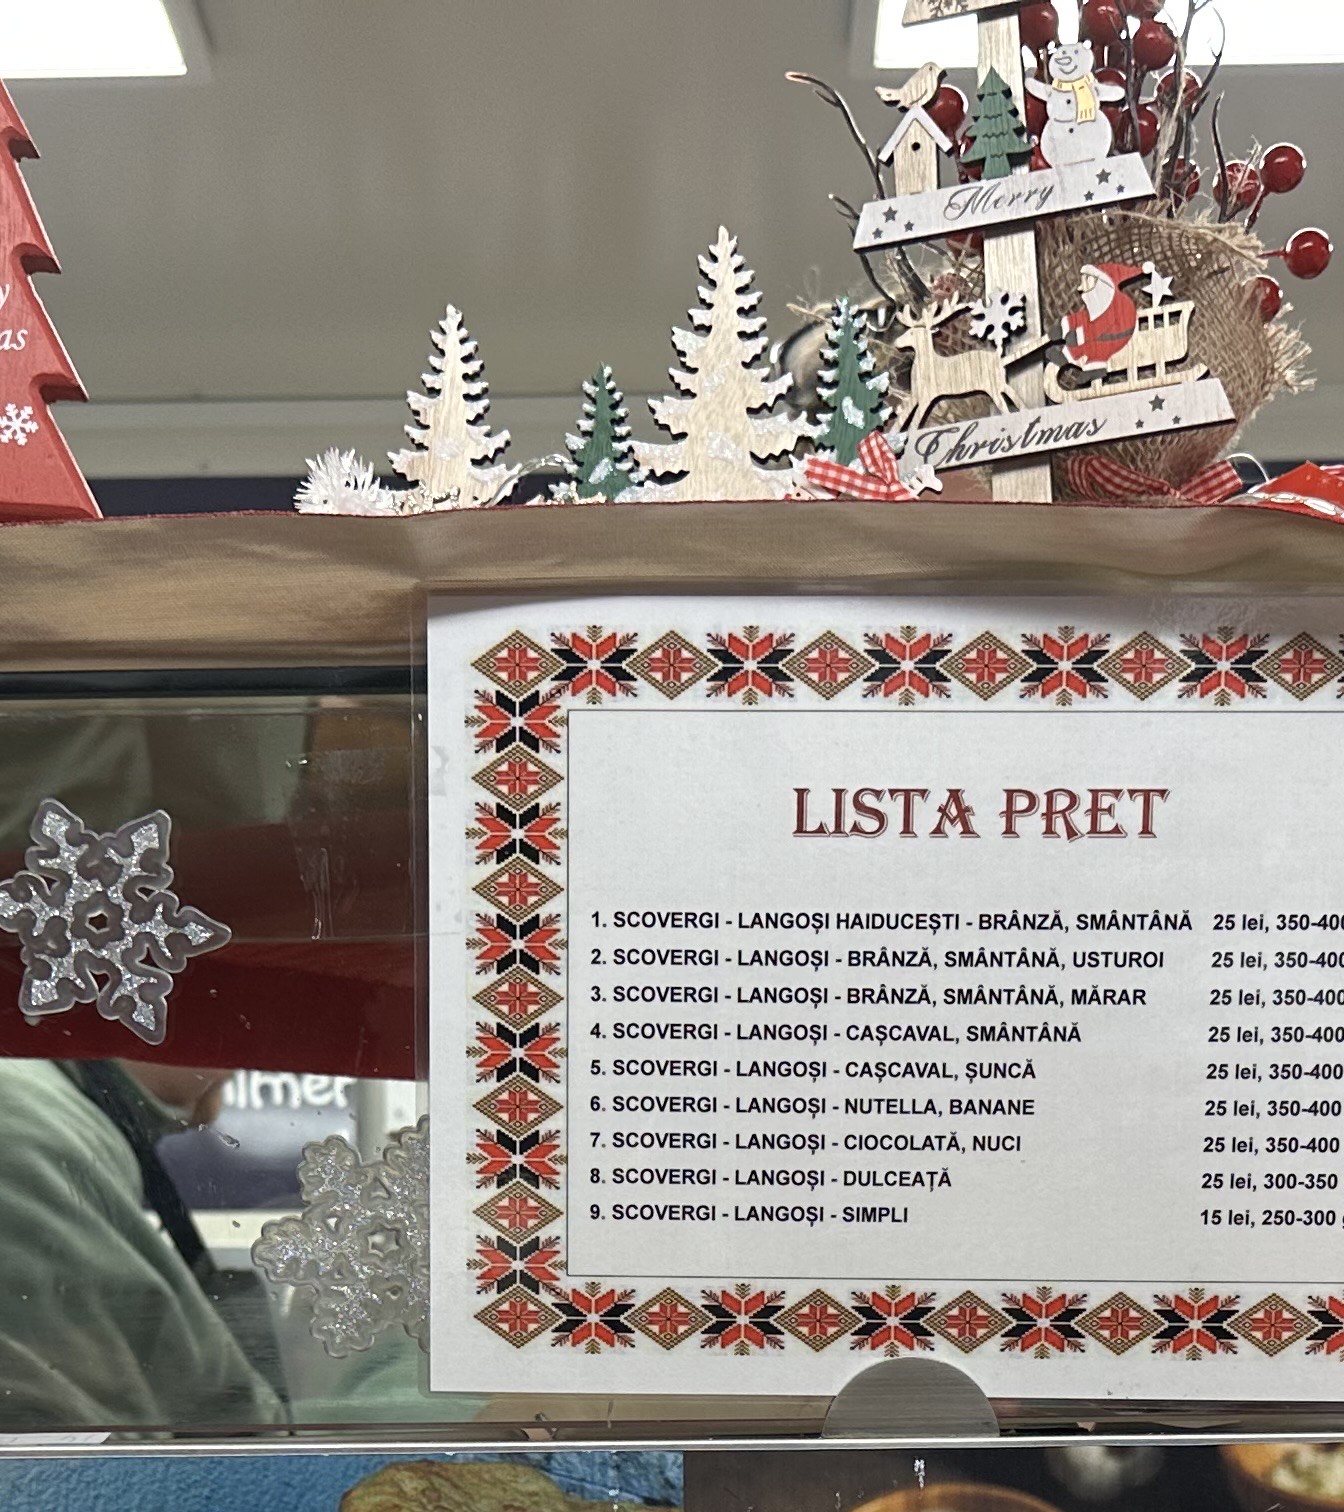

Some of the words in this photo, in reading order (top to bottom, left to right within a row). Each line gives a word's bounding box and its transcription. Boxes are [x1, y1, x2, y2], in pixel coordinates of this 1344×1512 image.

[943, 182, 1054, 221] Merry
[915, 415, 1108, 469] Christmas
[792, 787, 980, 839] LISTA
[999, 788, 1171, 842] PRET
[592, 911, 607, 928] 1.
[613, 911, 719, 929] SCOVERGI
[738, 912, 829, 935] LANGOȘI
[836, 913, 959, 936] HAIDUCEȘTI
[979, 910, 1069, 933] BRÂNZĂ,
[1076, 909, 1192, 930] SMÂNTÂNĂ
[1213, 914, 1235, 930] 25
[1242, 914, 1269, 933] lei,
[591, 948, 606, 965] 2.
[613, 948, 719, 966] SCOVERGI
[738, 950, 828, 972] LANGOȘI
[848, 946, 937, 970] BRÂNZĂ,
[944, 947, 1065, 971] SMÂNTÂNĂ,
[1073, 951, 1164, 968] USTUROI
[1211, 952, 1234, 968] 25
[1240, 952, 1267, 971] lei,
[590, 985, 606, 1002] 3.
[613, 986, 718, 1003] SCOVERGI
[737, 987, 828, 1009] LANGOȘI
[847, 984, 936, 1008] BRÂNZĂ,
[943, 984, 1064, 1008] SMÂNTÂNĂ,
[1071, 985, 1146, 1005] MĂRAR
[1209, 989, 1232, 1006] 25
[1238, 989, 1265, 1008] lei,
[590, 1023, 606, 1039] 4.
[613, 1023, 718, 1040] SCOVERGI
[737, 1024, 827, 1046] LANGOȘI
[846, 1025, 959, 1046] CAȘCAVAL,
[966, 1022, 1081, 1042] SMÂNTÂNĂ
[1208, 1026, 1230, 1043] 25
[1237, 1026, 1264, 1046] lei,
[590, 1059, 606, 1075] 5.
[613, 1059, 717, 1077] SCOVERGI
[736, 1061, 826, 1083] LANGOȘI
[845, 1061, 958, 1083] CAȘCAVAL,
[965, 1059, 1036, 1084] ȘUNCĂ
[1206, 1063, 1229, 1080] 25
[1235, 1063, 1262, 1083] lei,
[1269, 1063, 1344, 1080] 350-400
[590, 1096, 606, 1112] 6.
[612, 1096, 717, 1113] SCOVERGI
[736, 1097, 826, 1119] LANGOȘI
[845, 1098, 942, 1117] NUTELLA,
[950, 1099, 1035, 1115] BANANE
[1205, 1100, 1227, 1116] 25
[1234, 1100, 1260, 1119] lei,
[1267, 1100, 1342, 1117] 350-400
[590, 1132, 606, 1148] 7.
[612, 1132, 716, 1149] SCOVERGI
[736, 1133, 825, 1155] LANGOȘI
[844, 1131, 965, 1154] CIOCOLATĂ,
[973, 1135, 1021, 1152] NUCI
[1203, 1137, 1225, 1153] 25
[1232, 1137, 1258, 1156] lei,
[1265, 1137, 1340, 1153] 350-400
[590, 1168, 606, 1184] 8.
[612, 1168, 716, 1185] SCOVERGI
[735, 1169, 824, 1191] LANGOȘI
[844, 1167, 951, 1192] DULCEAȚĂ
[1201, 1173, 1224, 1189] 25
[1230, 1173, 1256, 1192] lei,
[1264, 1173, 1338, 1190] 300-350
[590, 1204, 605, 1220] 9.
[612, 1204, 716, 1221] SCOVERGI
[735, 1206, 824, 1227] LANGOȘI
[842, 1206, 908, 1223] SIMPLI
[1201, 1209, 1222, 1225] 15
[1228, 1209, 1255, 1228] lei,
[1262, 1210, 1336, 1226] 250-300
